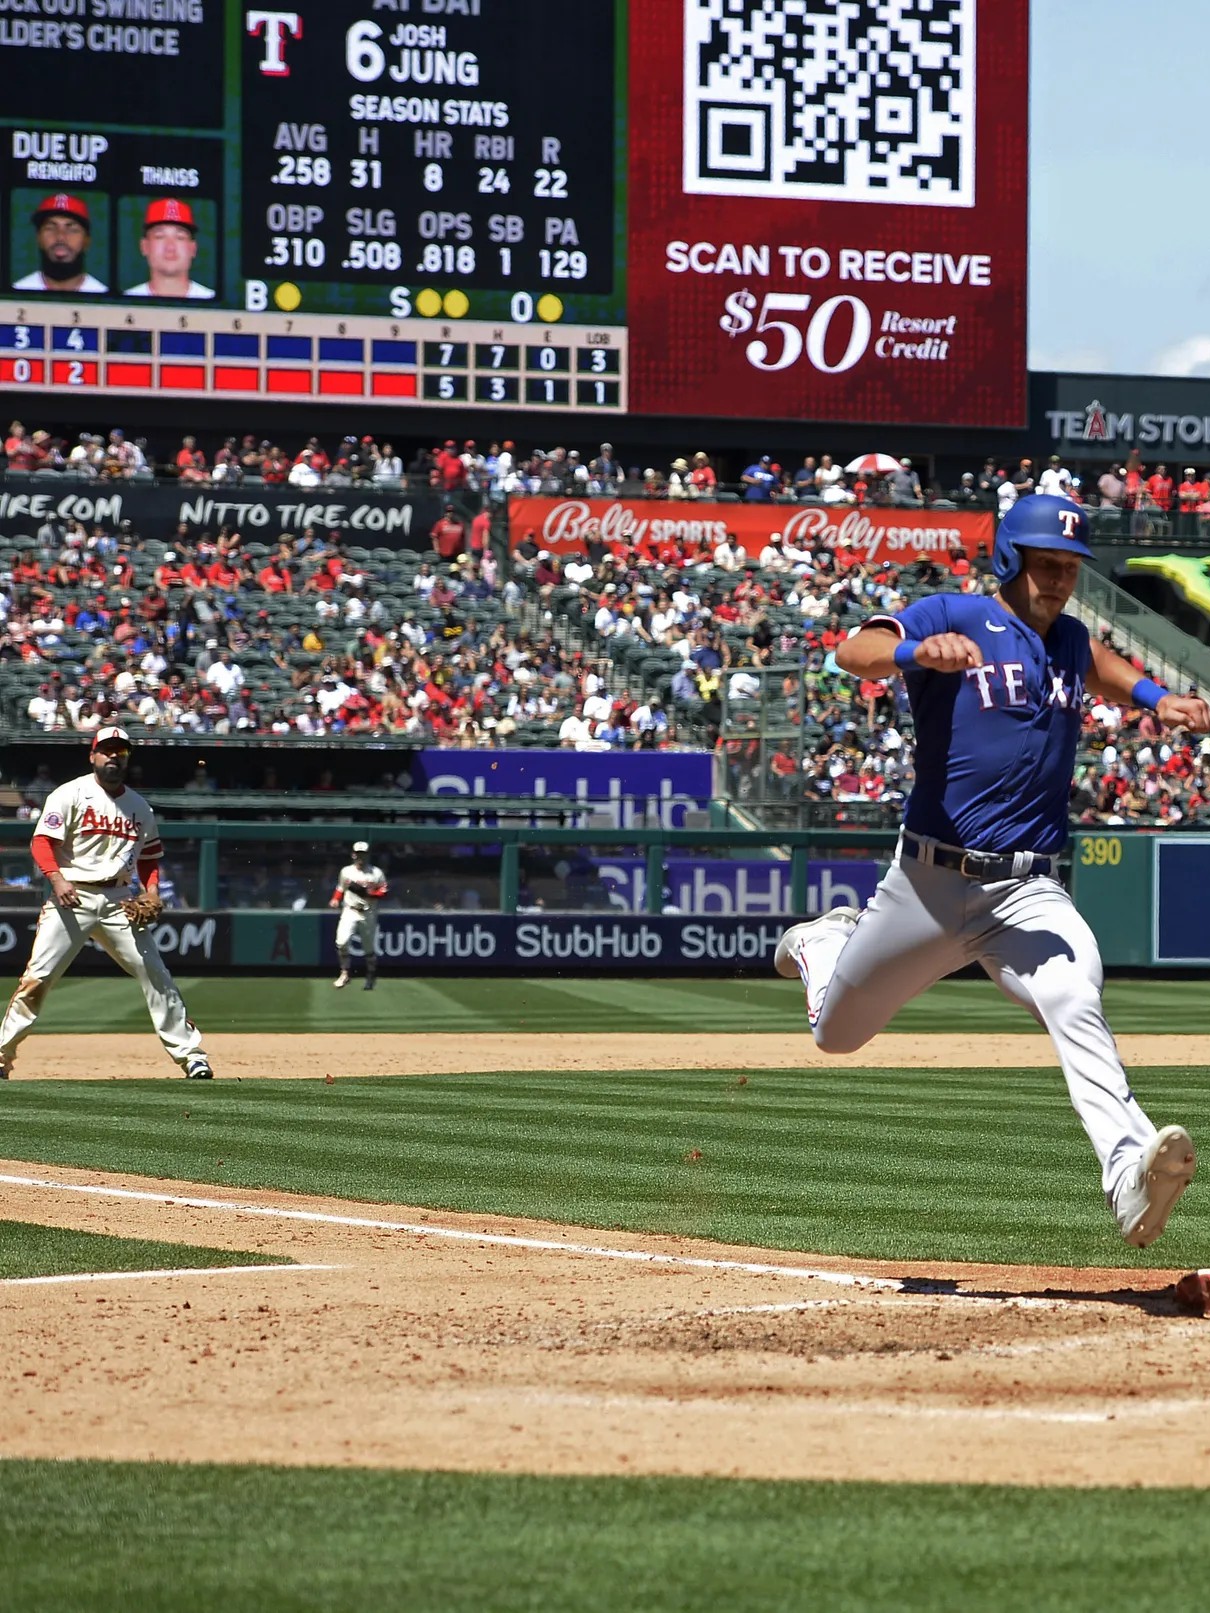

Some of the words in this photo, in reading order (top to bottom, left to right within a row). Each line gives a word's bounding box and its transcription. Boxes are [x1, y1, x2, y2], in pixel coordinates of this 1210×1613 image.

[87, 24, 180, 56] CHOICE
[246, 10, 303, 77] T
[346, 20, 386, 82] 6
[389, 24, 447, 48] JOSH
[389, 49, 480, 86] JUNG
[350, 94, 440, 123] SEASON
[443, 99, 510, 128] STATS
[12, 131, 67, 162] DUE
[69, 134, 109, 163] UP
[273, 122, 328, 153] AVG
[358, 126, 380, 155] H
[414, 129, 454, 159] HR
[474, 134, 516, 162] RBI
[541, 136, 562, 165] R
[27, 161, 97, 183] RENGIFO
[140, 165, 199, 187] THAISS
[270, 155, 332, 187] .258
[350, 159, 383, 189] 31
[423, 163, 444, 192] 8
[478, 167, 511, 195] 24
[533, 168, 569, 199] 22
[266, 203, 325, 234] OBP
[345, 207, 397, 237] SLG
[418, 210, 474, 240] OPS
[488, 213, 525, 243] SB
[545, 216, 580, 246] PA
[264, 237, 326, 267] .310
[341, 240, 402, 271] .508
[416, 243, 476, 274] .818
[499, 247, 512, 276] 1
[538, 249, 588, 280] 129
[665, 241, 770, 276] SCAN
[778, 246, 831, 279] TO
[839, 248, 992, 286] RECEIVE
[245, 279, 269, 311] B
[389, 286, 413, 319] S
[285, 319, 294, 333] 7
[544, 330, 553, 344] E
[585, 332, 611, 346] LOB
[719, 287, 872, 374] $50
[880, 310, 958, 335] Resort
[14, 325, 31, 350] 3
[66, 328, 85, 352] 4
[439, 343, 455, 366] 7
[490, 345, 506, 369] 7
[539, 347, 557, 371] 0
[590, 349, 608, 373] 3
[875, 335, 951, 361] Credit
[13, 358, 32, 384] 0
[68, 360, 84, 386] 2
[438, 375, 455, 400] 5
[490, 377, 506, 401] 3
[543, 379, 555, 403] 1
[594, 381, 606, 405] 1
[1045, 400, 1135, 441] TEAM
[180, 495, 271, 527] NITTO
[276, 502, 414, 536] TIRE.COM
[542, 500, 649, 545] Bally
[651, 518, 728, 544] SPORTS
[783, 508, 886, 563] Bally
[886, 527, 963, 552] SPORTS
[1058, 510, 1081, 538] T
[81, 805, 142, 836] Angels
[1080, 836, 1122, 866] 390
[515, 924, 663, 959] StubHub
[680, 924, 784, 959] StubH
